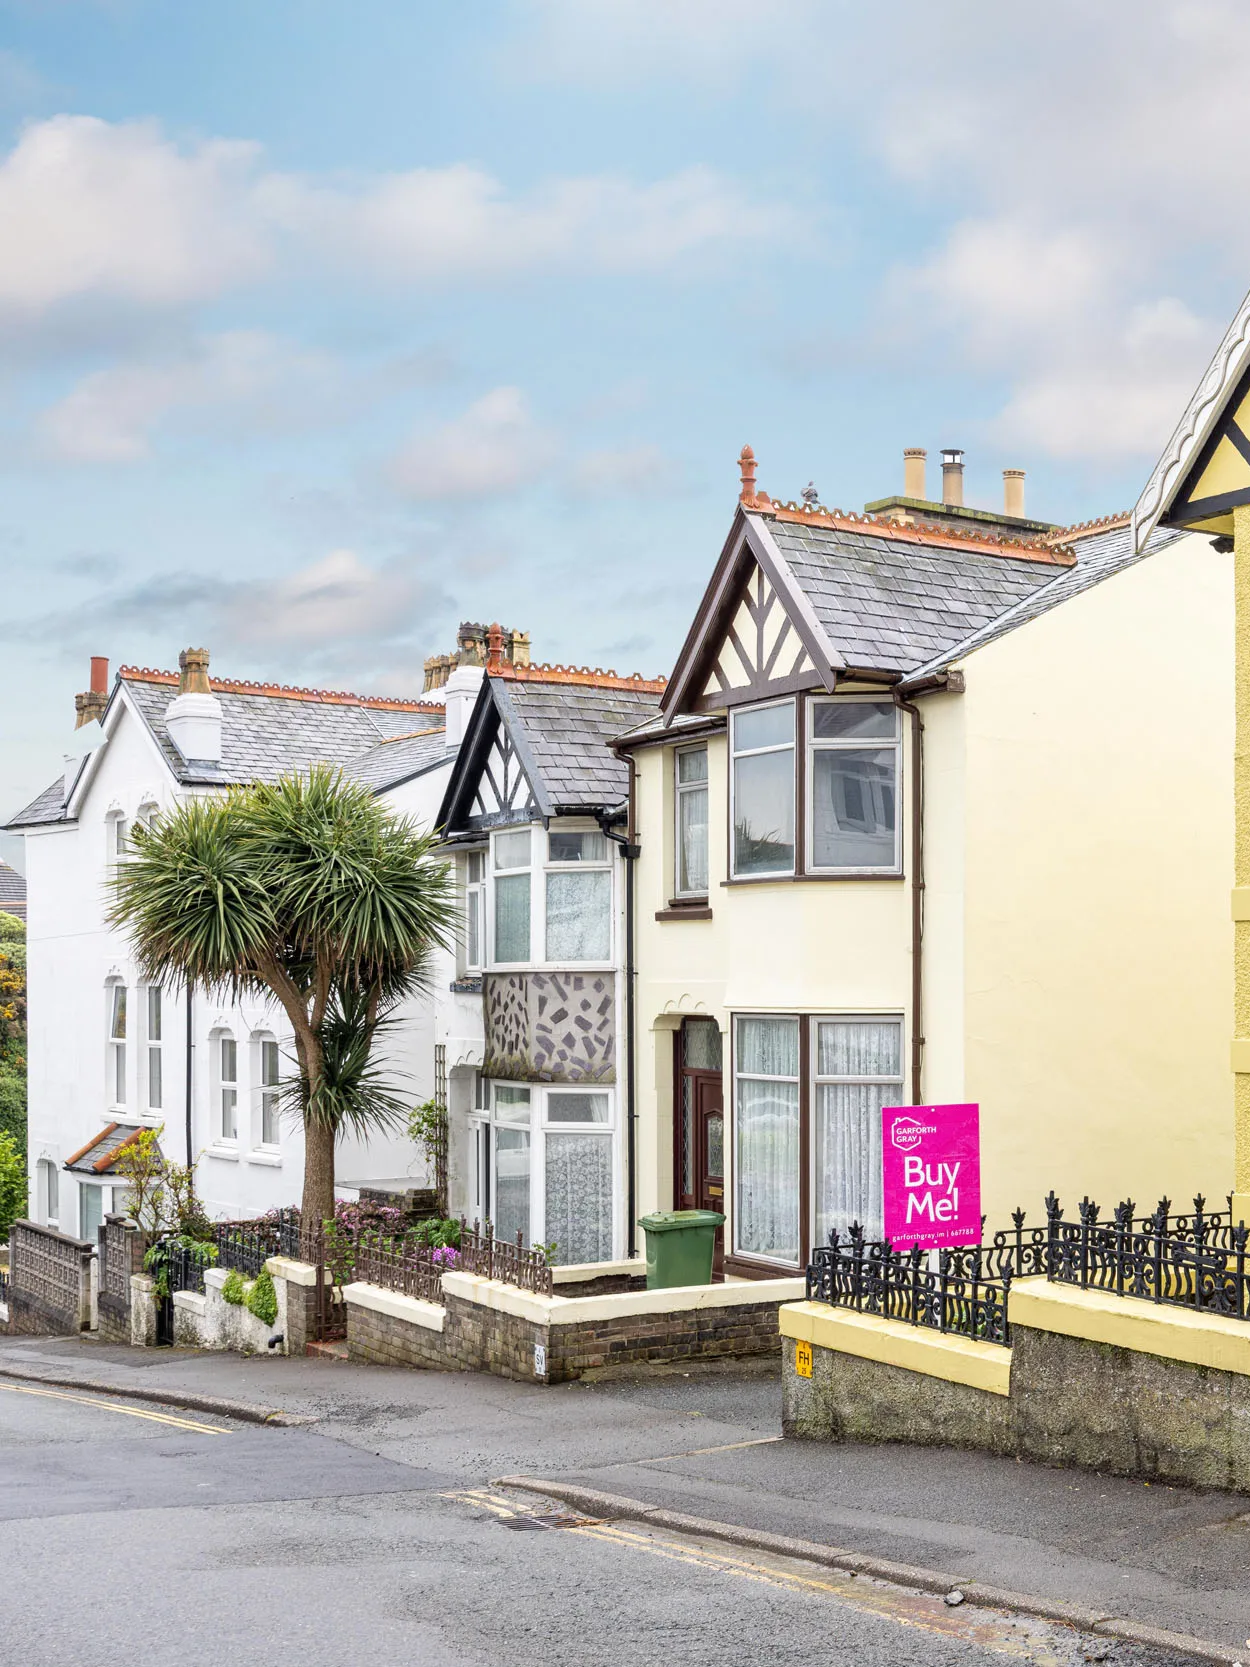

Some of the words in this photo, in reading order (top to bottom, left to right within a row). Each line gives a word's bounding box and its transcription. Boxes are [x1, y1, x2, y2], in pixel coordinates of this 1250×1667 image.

[896, 1126, 937, 1135] GARFORTH
[896, 1135, 917, 1143] GRAY
[904, 1156, 960, 1194] Buy
[905, 1188, 959, 1224] Me!
[892, 1231, 945, 1243] garforthgray.im
[950, 1228, 975, 1237] 667788
[536, 1353, 544, 1366] SV
[798, 1350, 810, 1366] FH
